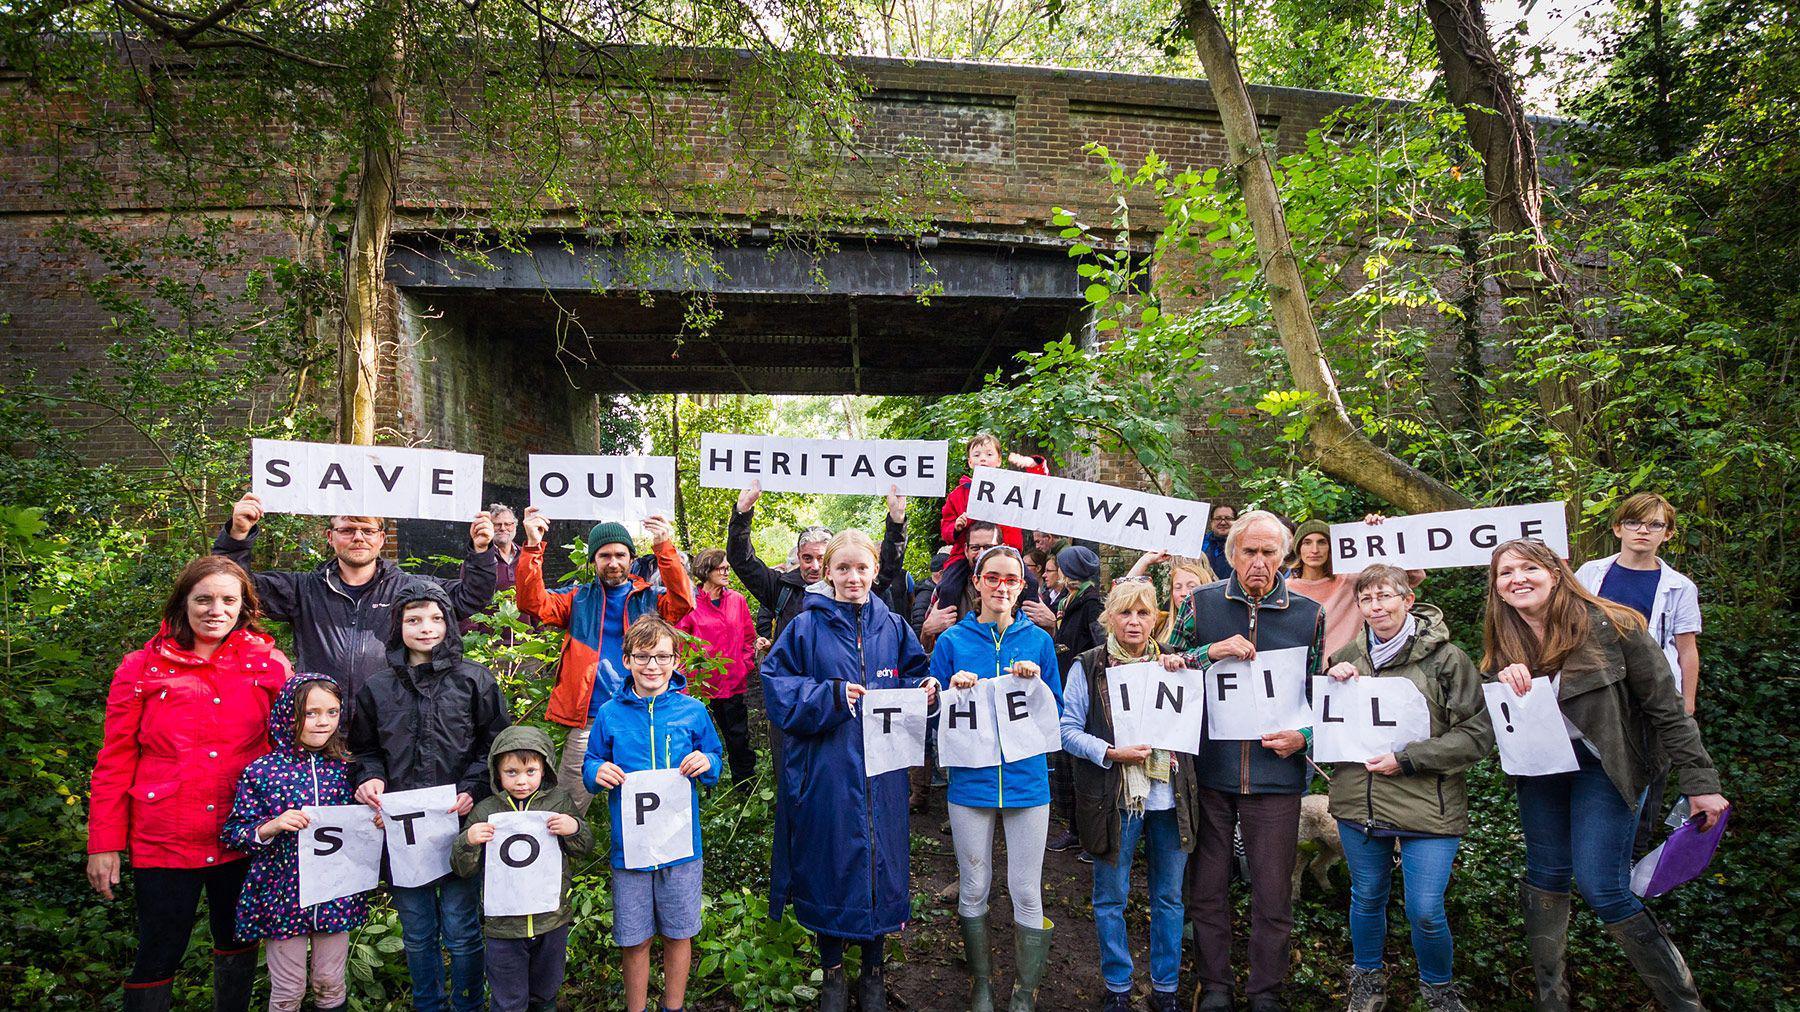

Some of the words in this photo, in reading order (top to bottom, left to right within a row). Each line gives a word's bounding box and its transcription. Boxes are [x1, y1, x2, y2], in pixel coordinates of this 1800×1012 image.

[264, 459, 455, 496] SAVE
[708, 448, 936, 479] HERITAGE
[539, 471, 658, 499] OUR
[976, 480, 1189, 537] RAILWAY
[1338, 519, 1542, 559] BRIDGE
[872, 690, 1029, 735] THE
[313, 792, 661, 869] STOP
